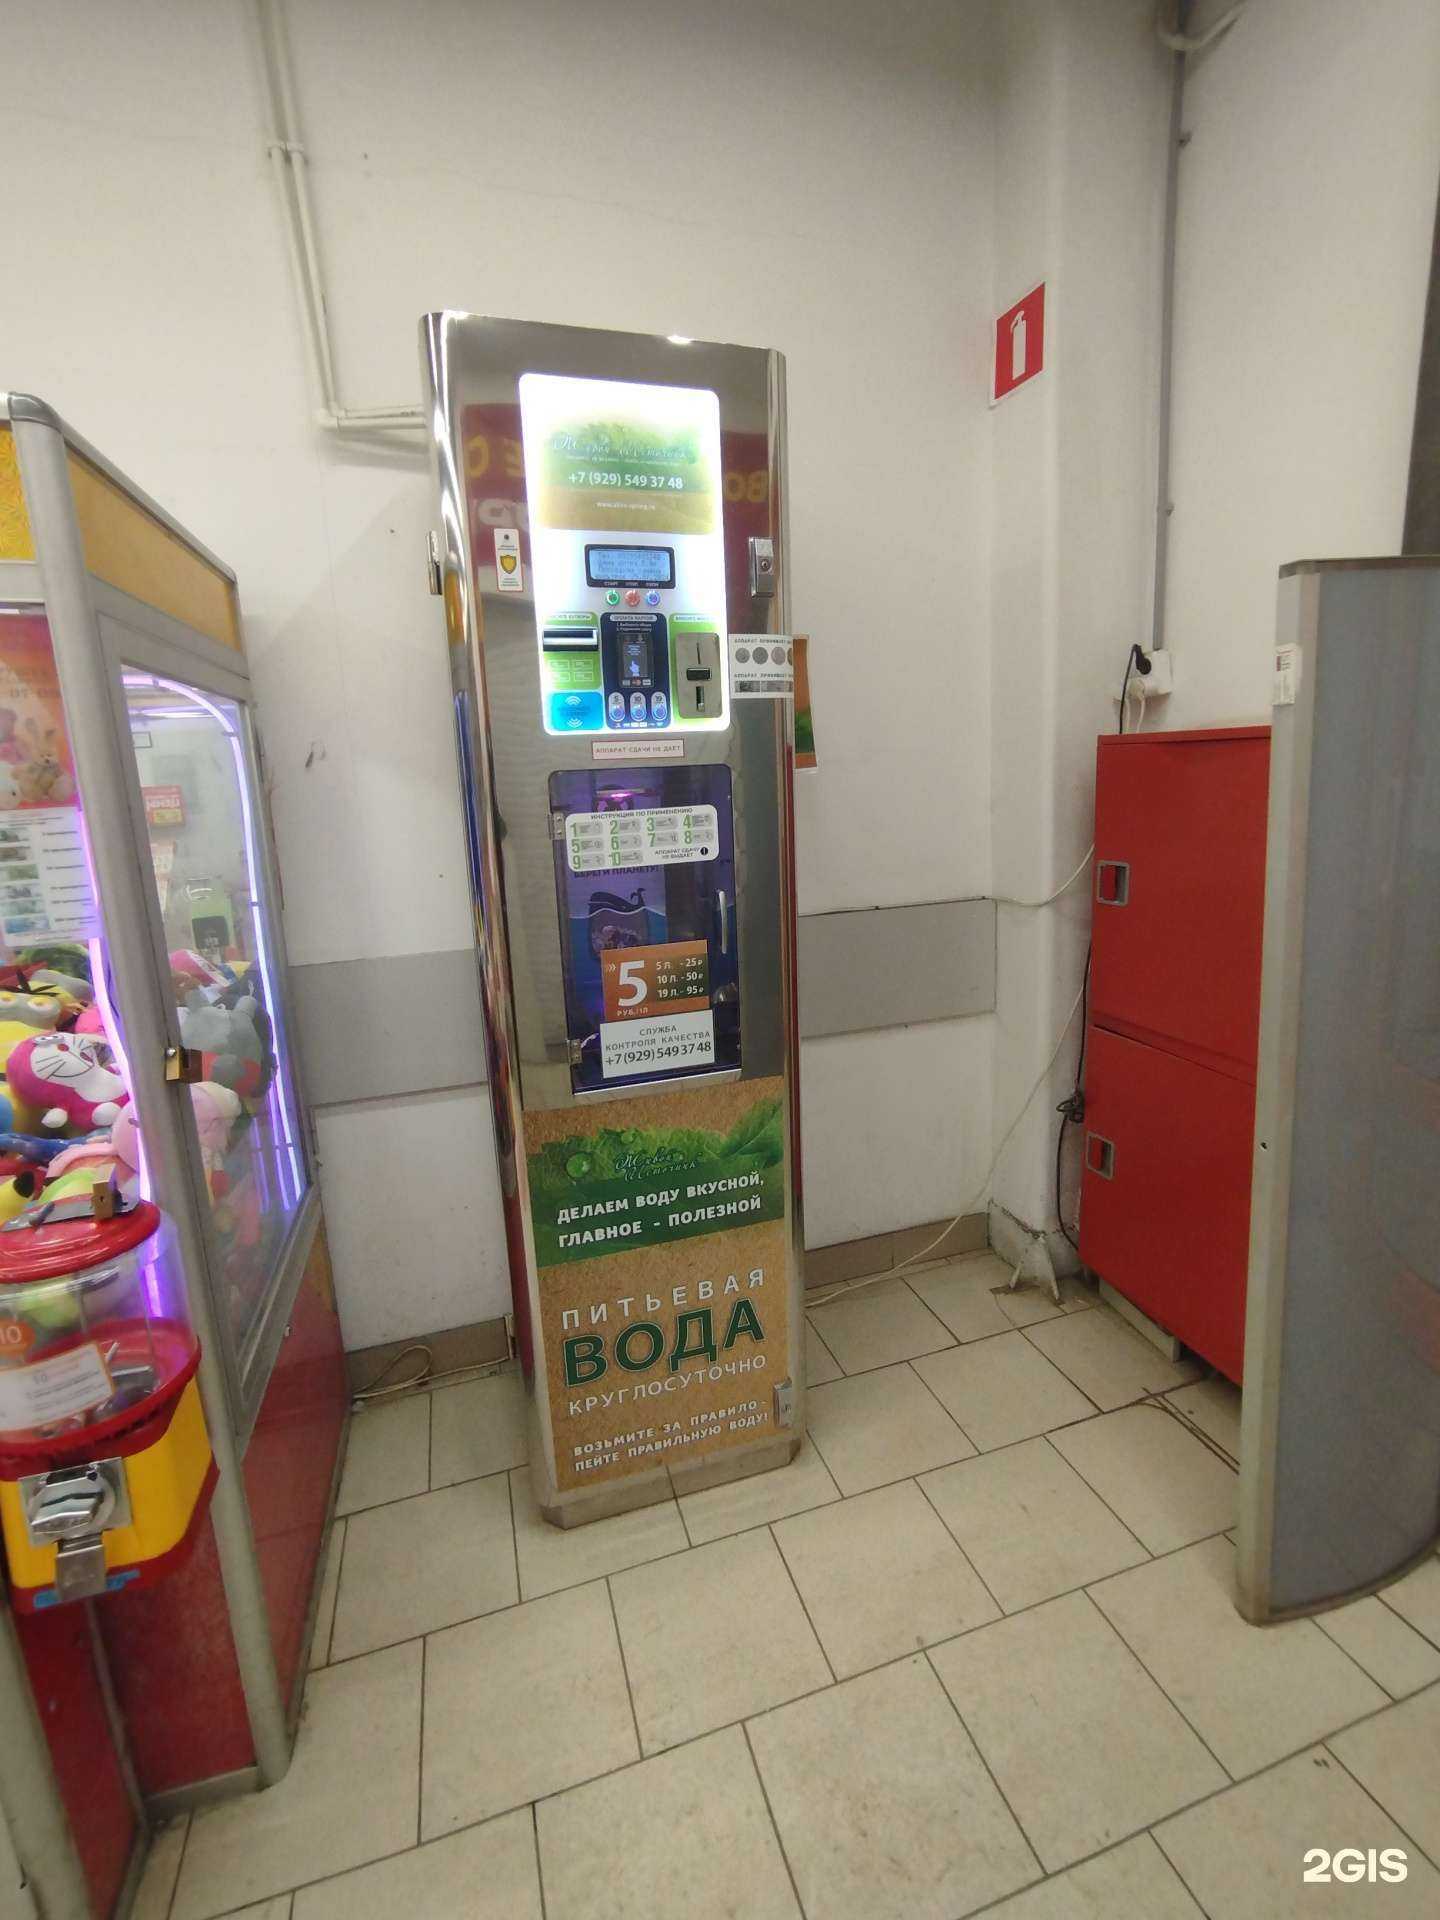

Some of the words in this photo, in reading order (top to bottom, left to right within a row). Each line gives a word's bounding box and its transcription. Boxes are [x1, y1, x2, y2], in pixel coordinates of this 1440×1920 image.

[568, 471, 586, 484] +7
[588, 472, 621, 486] (929)
[624, 474, 648, 487] 549
[650, 475, 664, 488] 37
[667, 476, 684, 490] 48
[647, 807, 693, 816] ПРИМЕНЕНИЮ
[570, 823, 578, 837] 1
[610, 820, 618, 835] 2
[647, 817, 655, 832] 3
[683, 814, 692, 829] 4
[571, 838, 580, 854] 5
[611, 836, 619, 851] 6
[647, 833, 656, 847] 7
[684, 830, 692, 844] 8
[572, 855, 581, 870] 9
[609, 851, 621, 867] 10
[655, 961, 662, 970] 5
[618, 959, 648, 1007] 5
[657, 975, 668, 984] 10
[657, 988, 669, 998] 19
[605, 1038, 657, 1052] КОНТРОЛЯ
[661, 1031, 711, 1044] КАЧЕСТВА
[640, 1025, 677, 1036] СЛУЖБА
[557, 1197, 629, 1225] ДЕЛАЕМ
[635, 1188, 680, 1208] ВОДУ
[686, 1170, 764, 1198] ВКУСНОЙ,
[558, 1220, 643, 1248] ГЛАВНОЕ
[668, 1194, 761, 1227] ПОЛЕЗНОЙ
[562, 1268, 764, 1330] ПИТЬЕВАЯ
[563, 1297, 765, 1388] ВОДА
[569, 1355, 766, 1416] КРУГЛОСУТОЧНО
[574, 1427, 655, 1457] ВОЗЬМИТЕ
[663, 1422, 681, 1434] ЗА
[690, 1400, 757, 1426] ПРАВИЛО
[575, 1451, 620, 1472] ПЕЙТЕ
[628, 1424, 721, 1457] ПРАВИЛЬНУЮ
[730, 1412, 769, 1431] ВОДУ!
